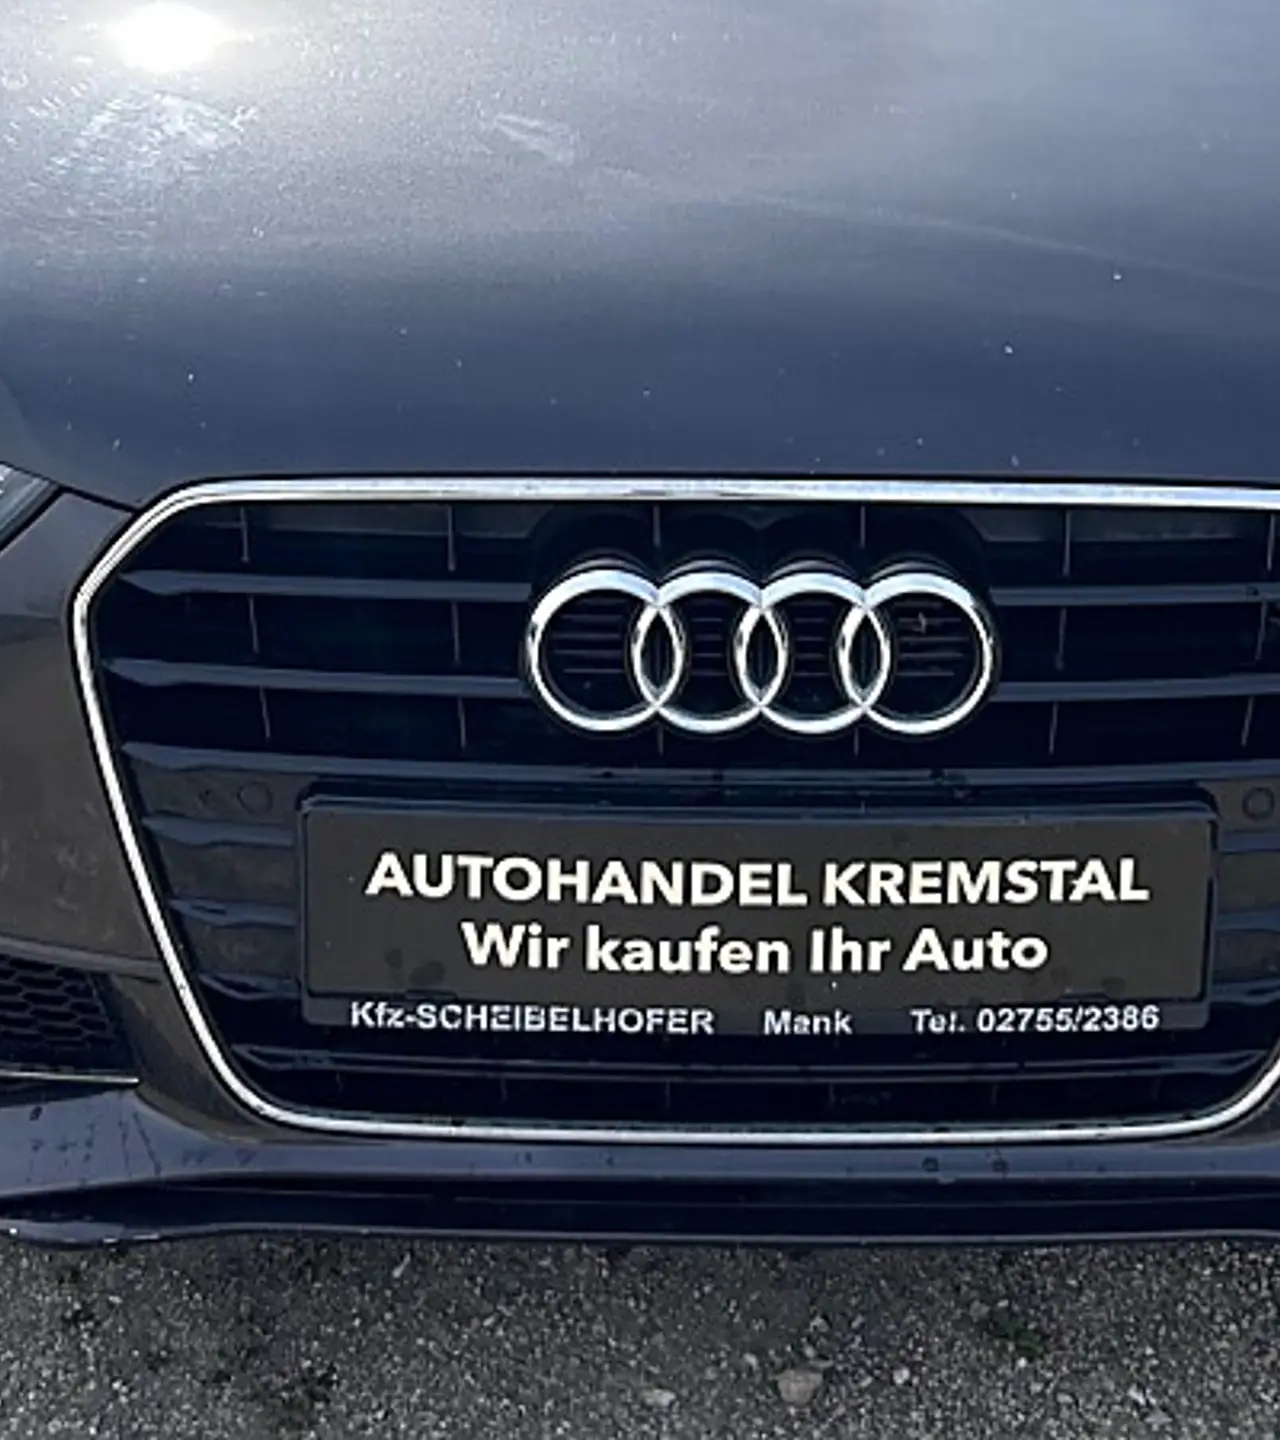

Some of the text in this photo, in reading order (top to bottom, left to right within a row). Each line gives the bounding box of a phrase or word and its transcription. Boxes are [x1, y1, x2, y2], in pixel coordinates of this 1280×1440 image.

[364, 852, 1150, 907] AUTOHANDEL KREMSTAL
[460, 920, 1049, 974] Wir kaufen Ihr Auto
[350, 1000, 1161, 1036] Kfz-SCHEIBELHOFER Mank Tel. 02755/2386
